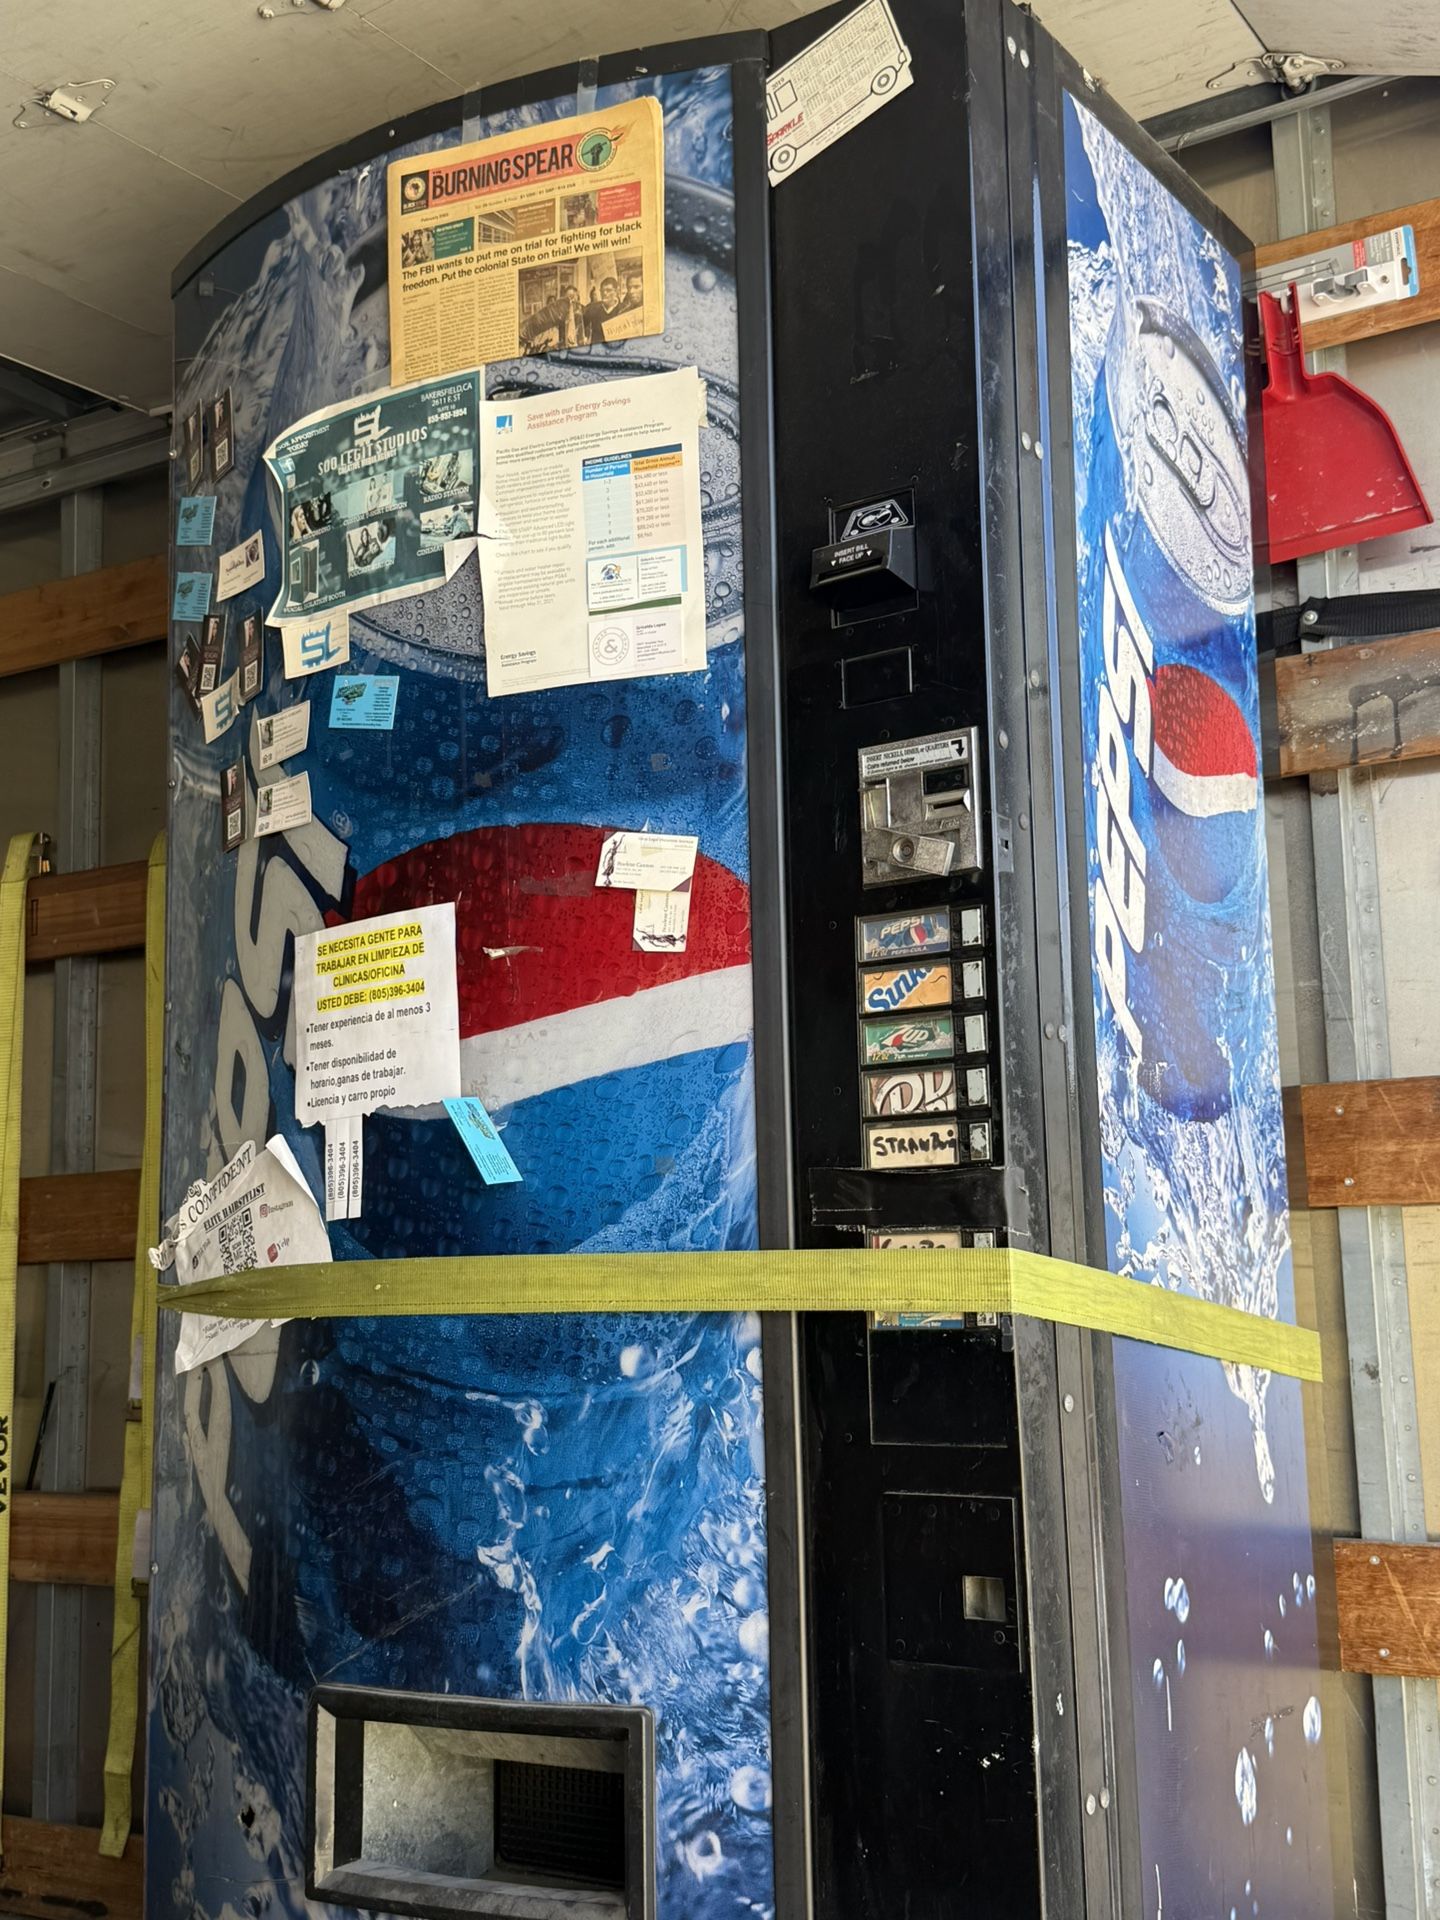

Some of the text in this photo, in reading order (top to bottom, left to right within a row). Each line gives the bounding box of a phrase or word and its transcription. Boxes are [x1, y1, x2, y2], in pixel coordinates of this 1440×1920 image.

[432, 158, 510, 200] BURNING
[512, 143, 573, 180] SPEAR
[402, 221, 642, 280] The FBI wants to put me on trial for fighting for black
[402, 236, 630, 292] freedom. Put the colonial State on trial! We will win!
[527, 397, 631, 422] Save with our Energy Savings
[527, 411, 598, 430] Assistance Program
[287, 440, 309, 452] TODAY
[318, 426, 428, 476] SOO LEGIT STUDIOS
[604, 453, 632, 462] GUIDELINES
[423, 486, 469, 504] RADIO STATION
[839, 554, 854, 564] FACE
[856, 544, 868, 552] BILL
[866, 754, 882, 762] INSERT
[925, 742, 949, 753] QUARTERS
[881, 759, 900, 768] returned
[1096, 519, 1153, 1060] PEPSI
[881, 915, 924, 939] PEPSI
[318, 924, 422, 956] SE NECESITA GENTE PARA
[316, 942, 424, 974] TRABAJAR EN LIMPIEZA DE
[333, 964, 405, 988] CLINICAS/OFICINA
[317, 980, 425, 1010] USTED DEBE: (805)396-3404
[310, 1002, 431, 1034] Tener experiencia de al menos 3
[310, 1040, 334, 1051] meses.
[310, 1048, 396, 1072] Tener disponibilidad de
[361, 1070, 370, 1081] de
[373, 1066, 406, 1079] trabajar.
[311, 1086, 396, 1108] Licencia y carro propio
[338, 1142, 346, 1199] (805)396-3404
[352, 1140, 360, 1198] (805)396-3404
[188, 1144, 252, 1223] CONFIDENT
[203, 1216, 221, 1231] ELITE
[222, 1183, 265, 1218] HAIRSTYLIST
